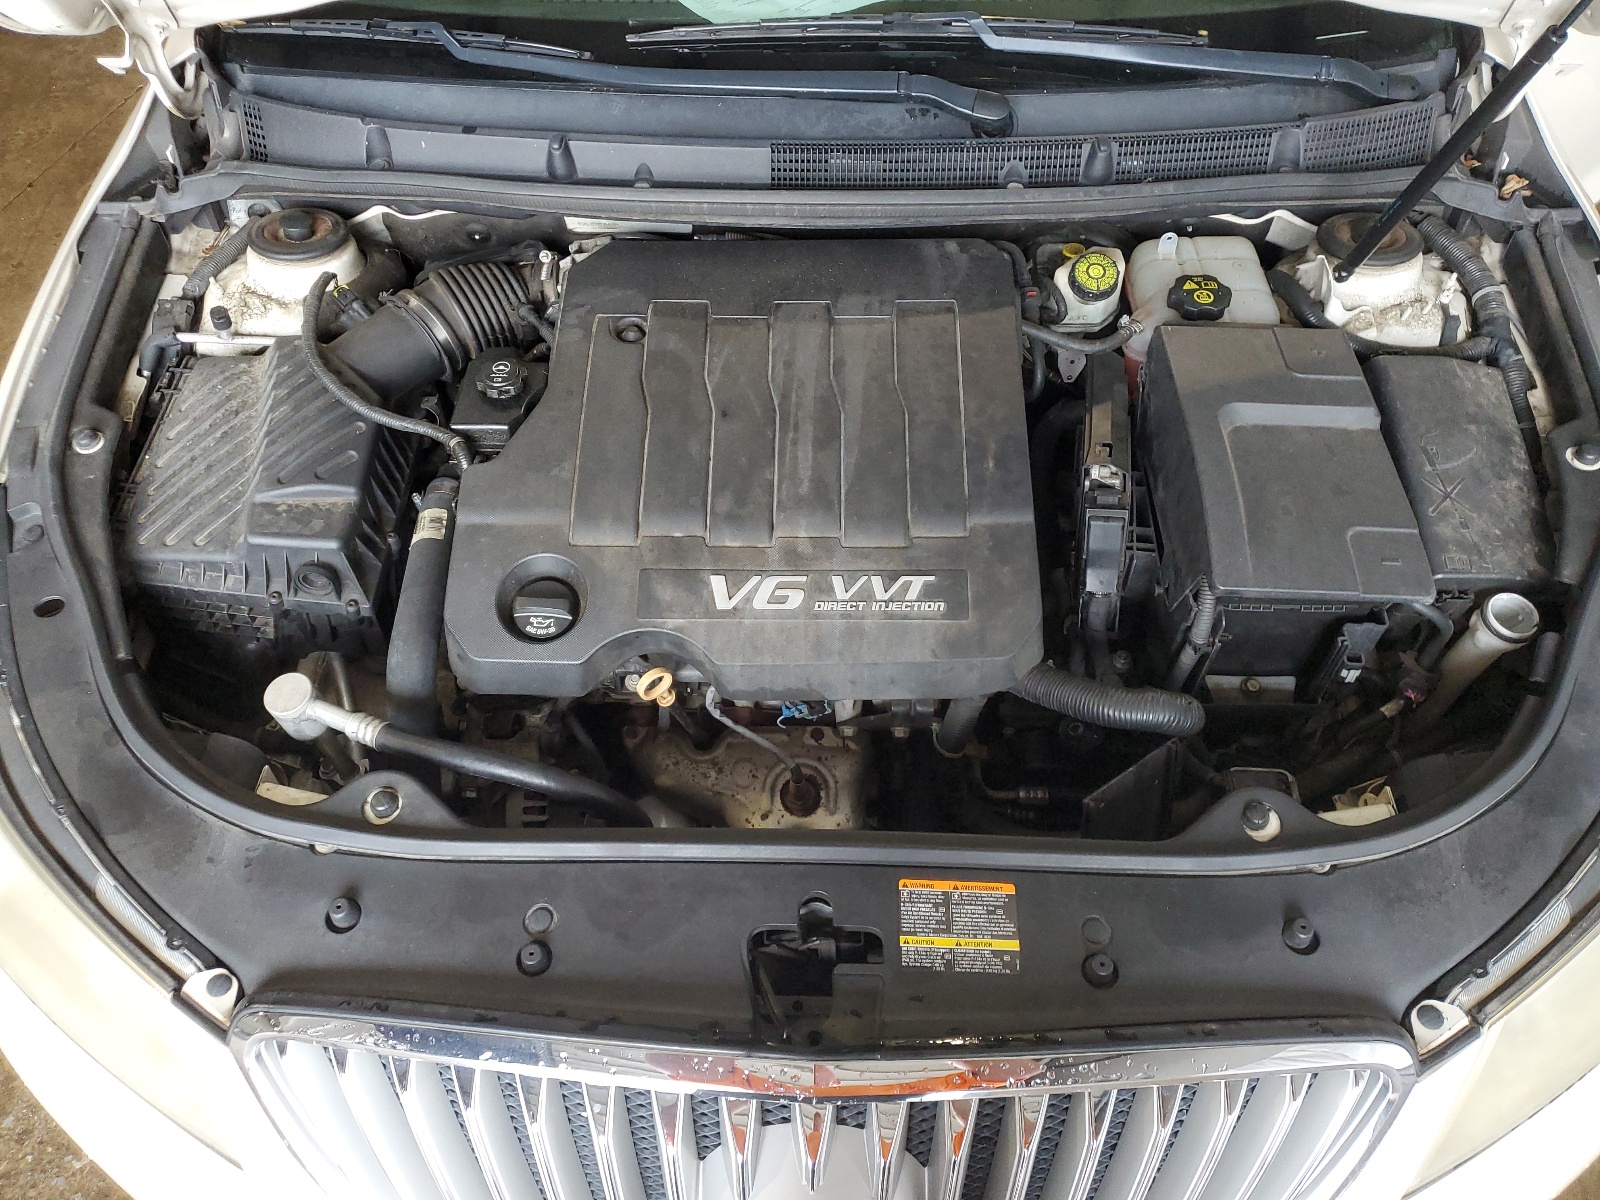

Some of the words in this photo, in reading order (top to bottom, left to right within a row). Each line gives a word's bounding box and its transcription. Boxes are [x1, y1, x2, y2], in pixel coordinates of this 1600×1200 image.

[710, 575, 808, 610] V6
[831, 575, 936, 600] VVT
[814, 601, 867, 611] DIRECT
[871, 601, 945, 611] INJECTION
[525, 625, 537, 634] SAE
